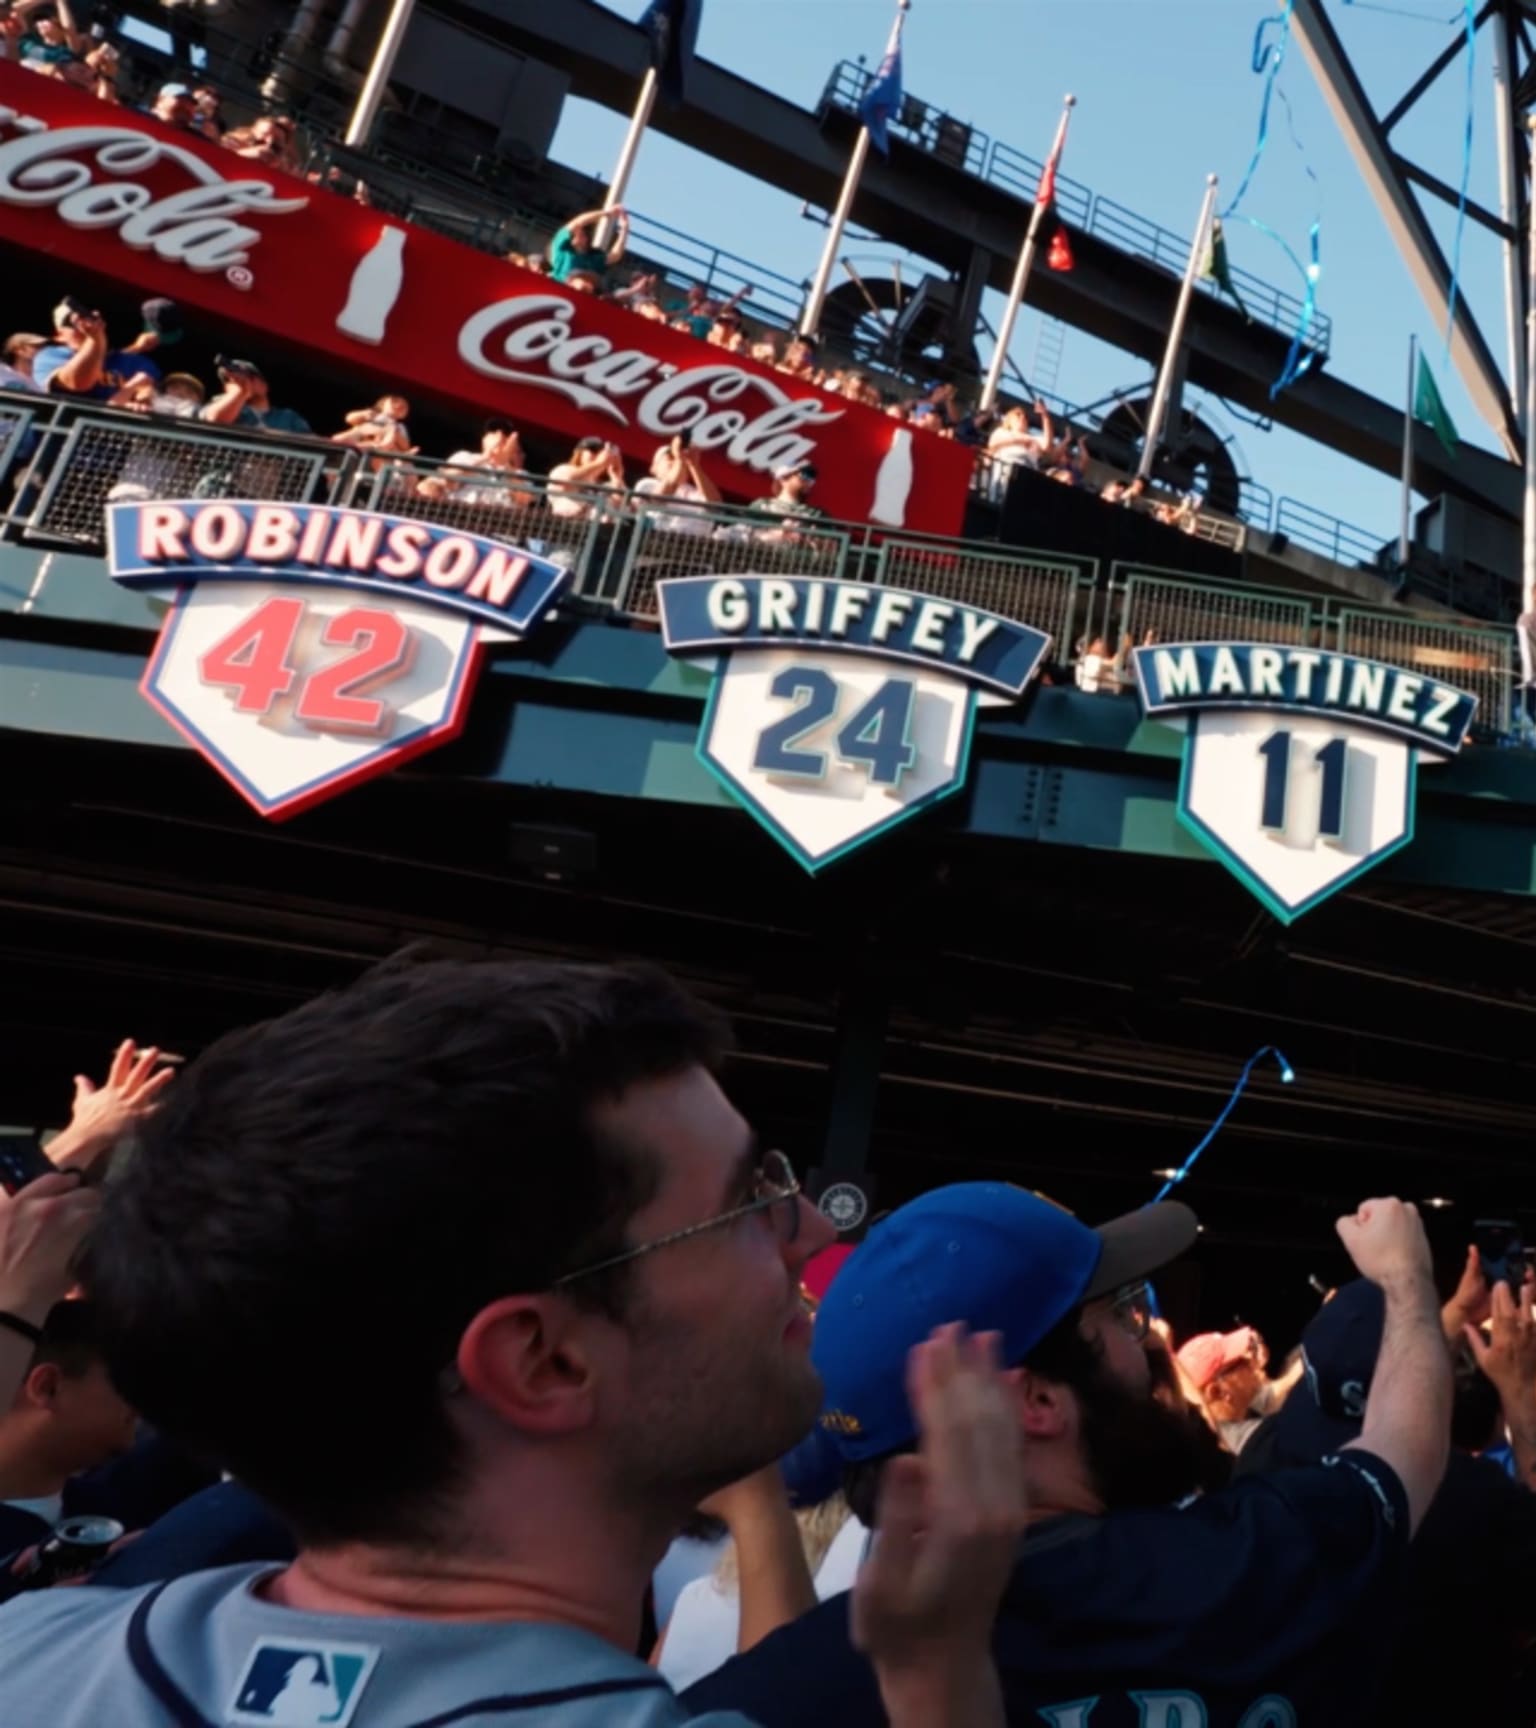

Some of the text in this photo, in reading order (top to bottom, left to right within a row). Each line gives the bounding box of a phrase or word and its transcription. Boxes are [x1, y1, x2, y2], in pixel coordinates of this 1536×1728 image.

[457, 294, 845, 474] Coca-Cola
[138, 506, 530, 606] ROBINSON
[197, 595, 409, 730] 42
[706, 578, 1000, 664] GRIFFEY
[750, 665, 918, 788] 24
[1154, 646, 1460, 736] MARTINEZ
[1256, 729, 1350, 839] 11
